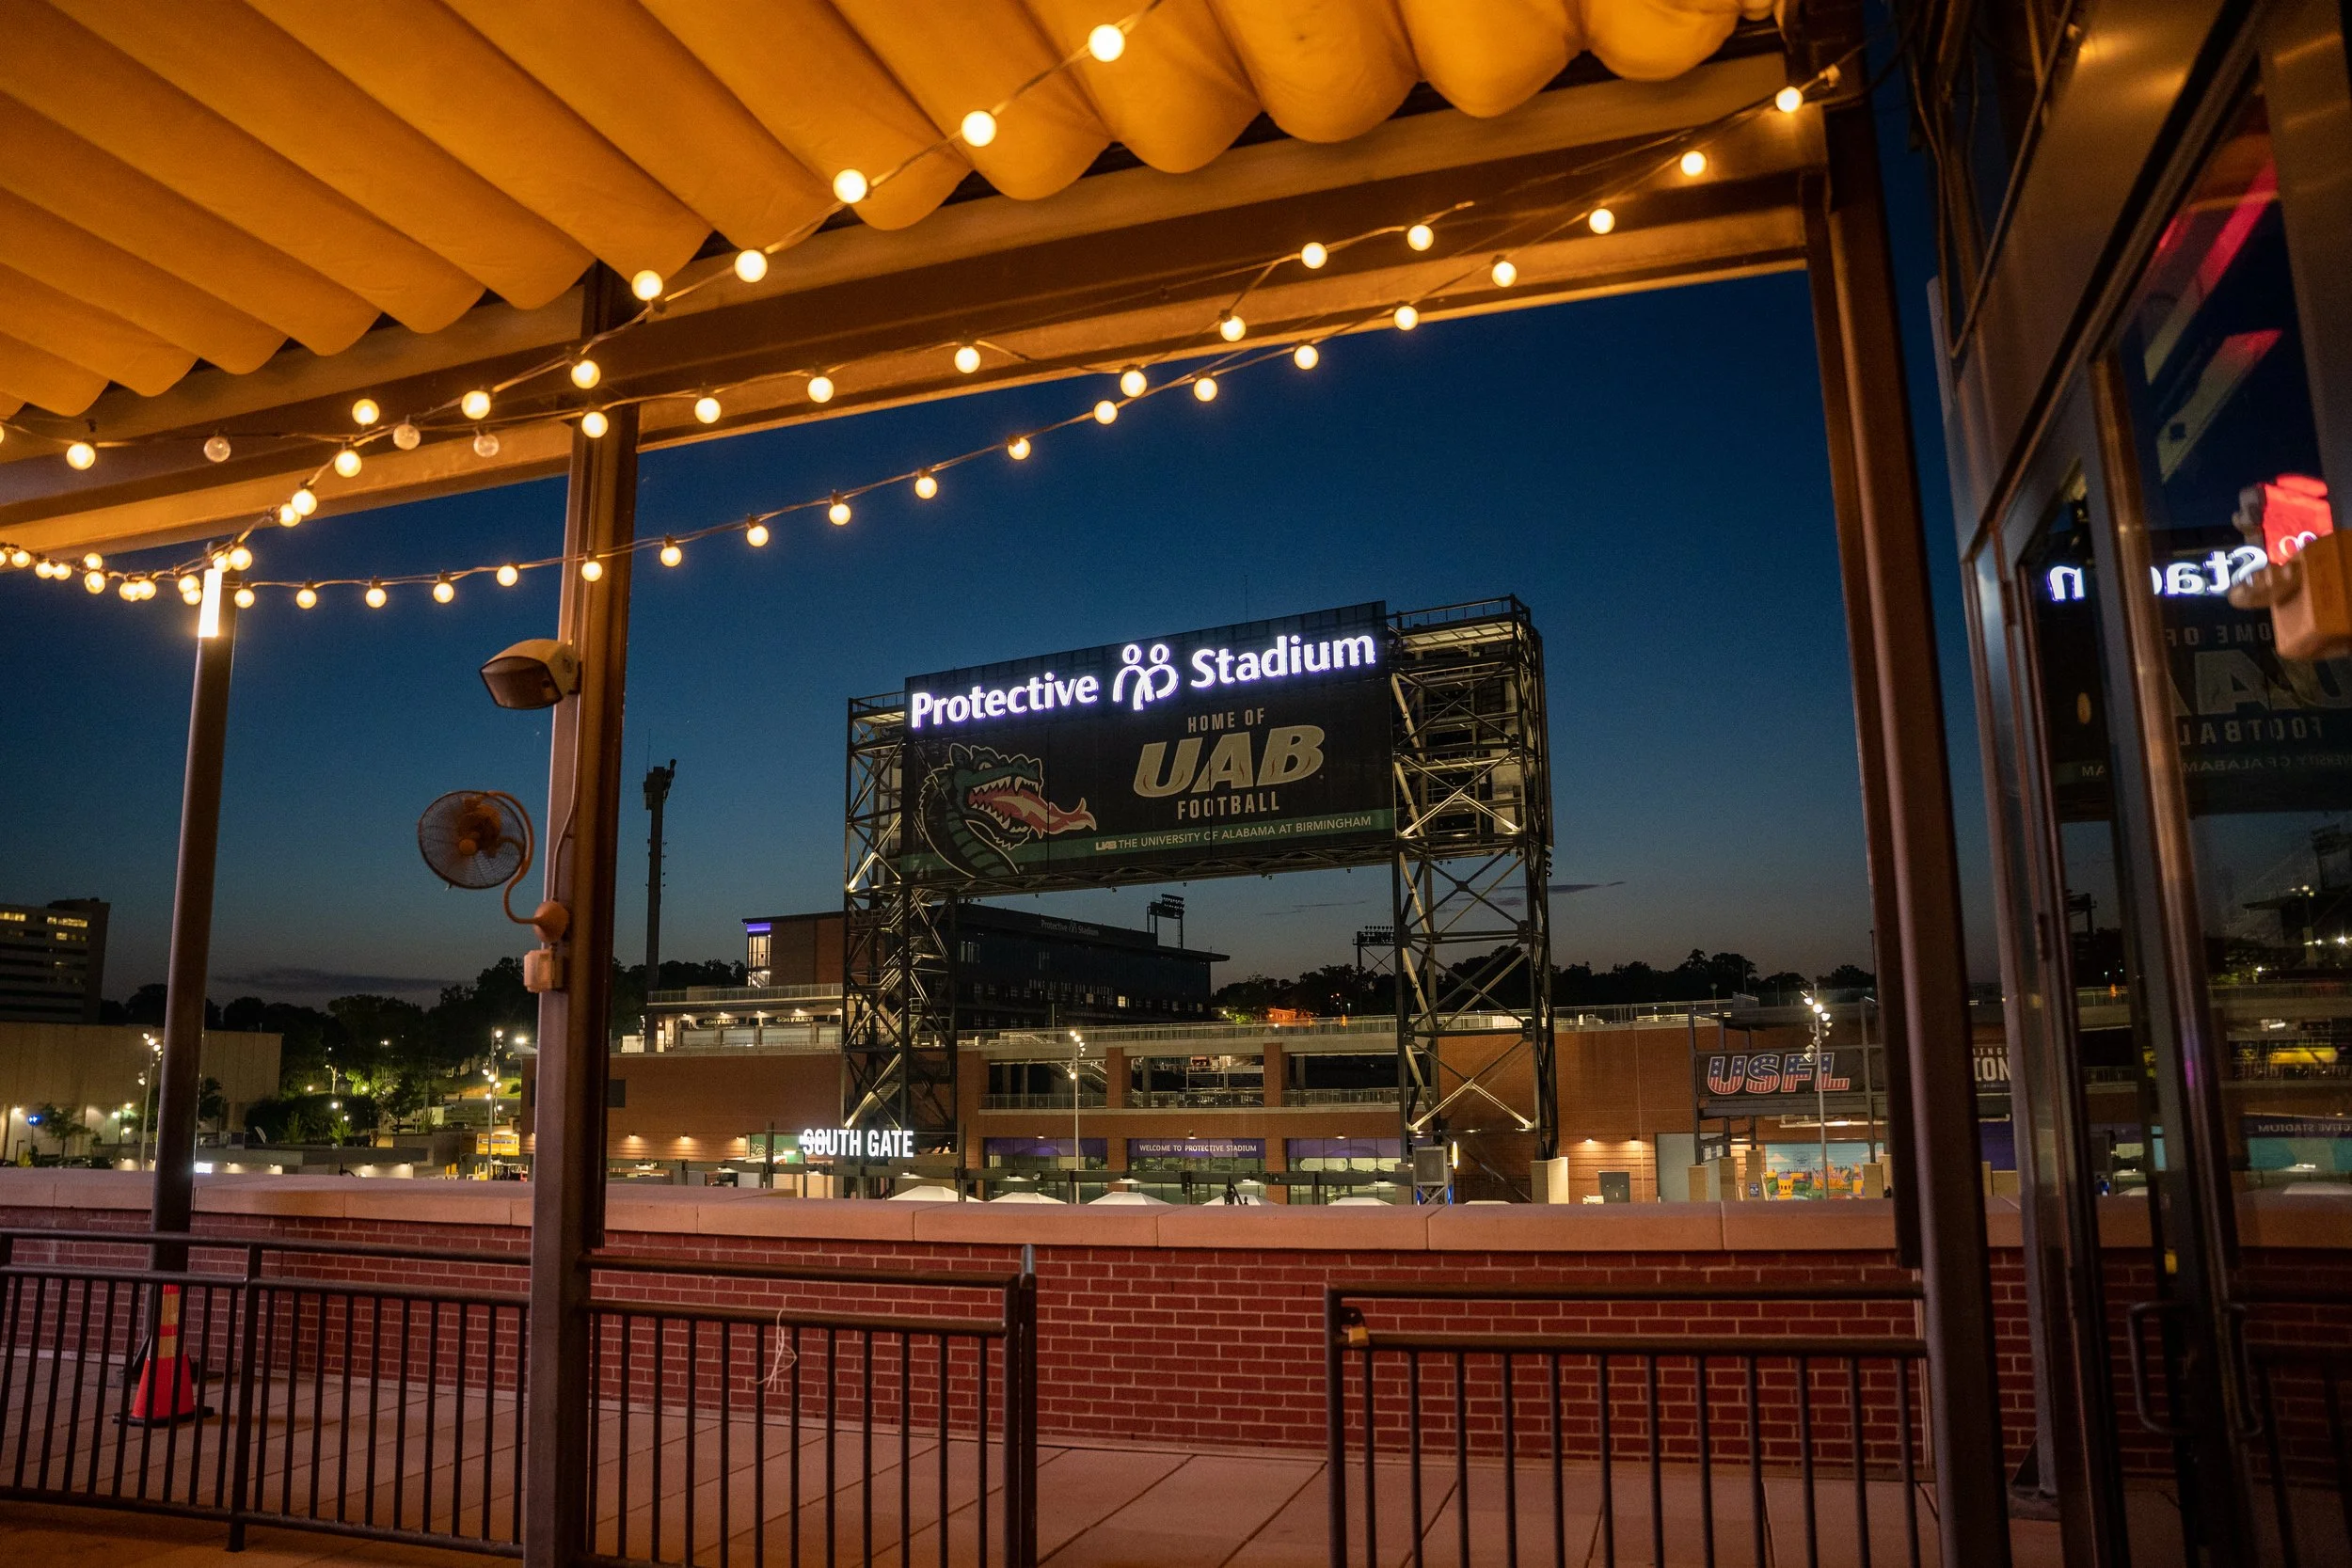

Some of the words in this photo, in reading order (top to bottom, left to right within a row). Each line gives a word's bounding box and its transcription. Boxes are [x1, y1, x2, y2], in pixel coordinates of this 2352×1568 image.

[911, 672, 1099, 729] Protective
[1190, 634, 1376, 689] Stadium
[1187, 711, 1235, 733] HOME
[1245, 707, 1264, 726] OF
[1133, 724, 1326, 798] UAB
[1177, 791, 1280, 820] FOOTBALL
[1095, 840, 1118, 851] UAB
[1118, 838, 1137, 848] THE
[1141, 832, 1200, 847] UNIVERSITY
[1203, 831, 1218, 841] OF
[1222, 826, 1276, 839] ALABAMA
[1279, 823, 1293, 834] AT
[1295, 816, 1372, 832] BIRMINGHAM
[1707, 1052, 1851, 1095] USFL
[803, 1128, 862, 1156] SOUTH
[867, 1129, 914, 1158] GATE
